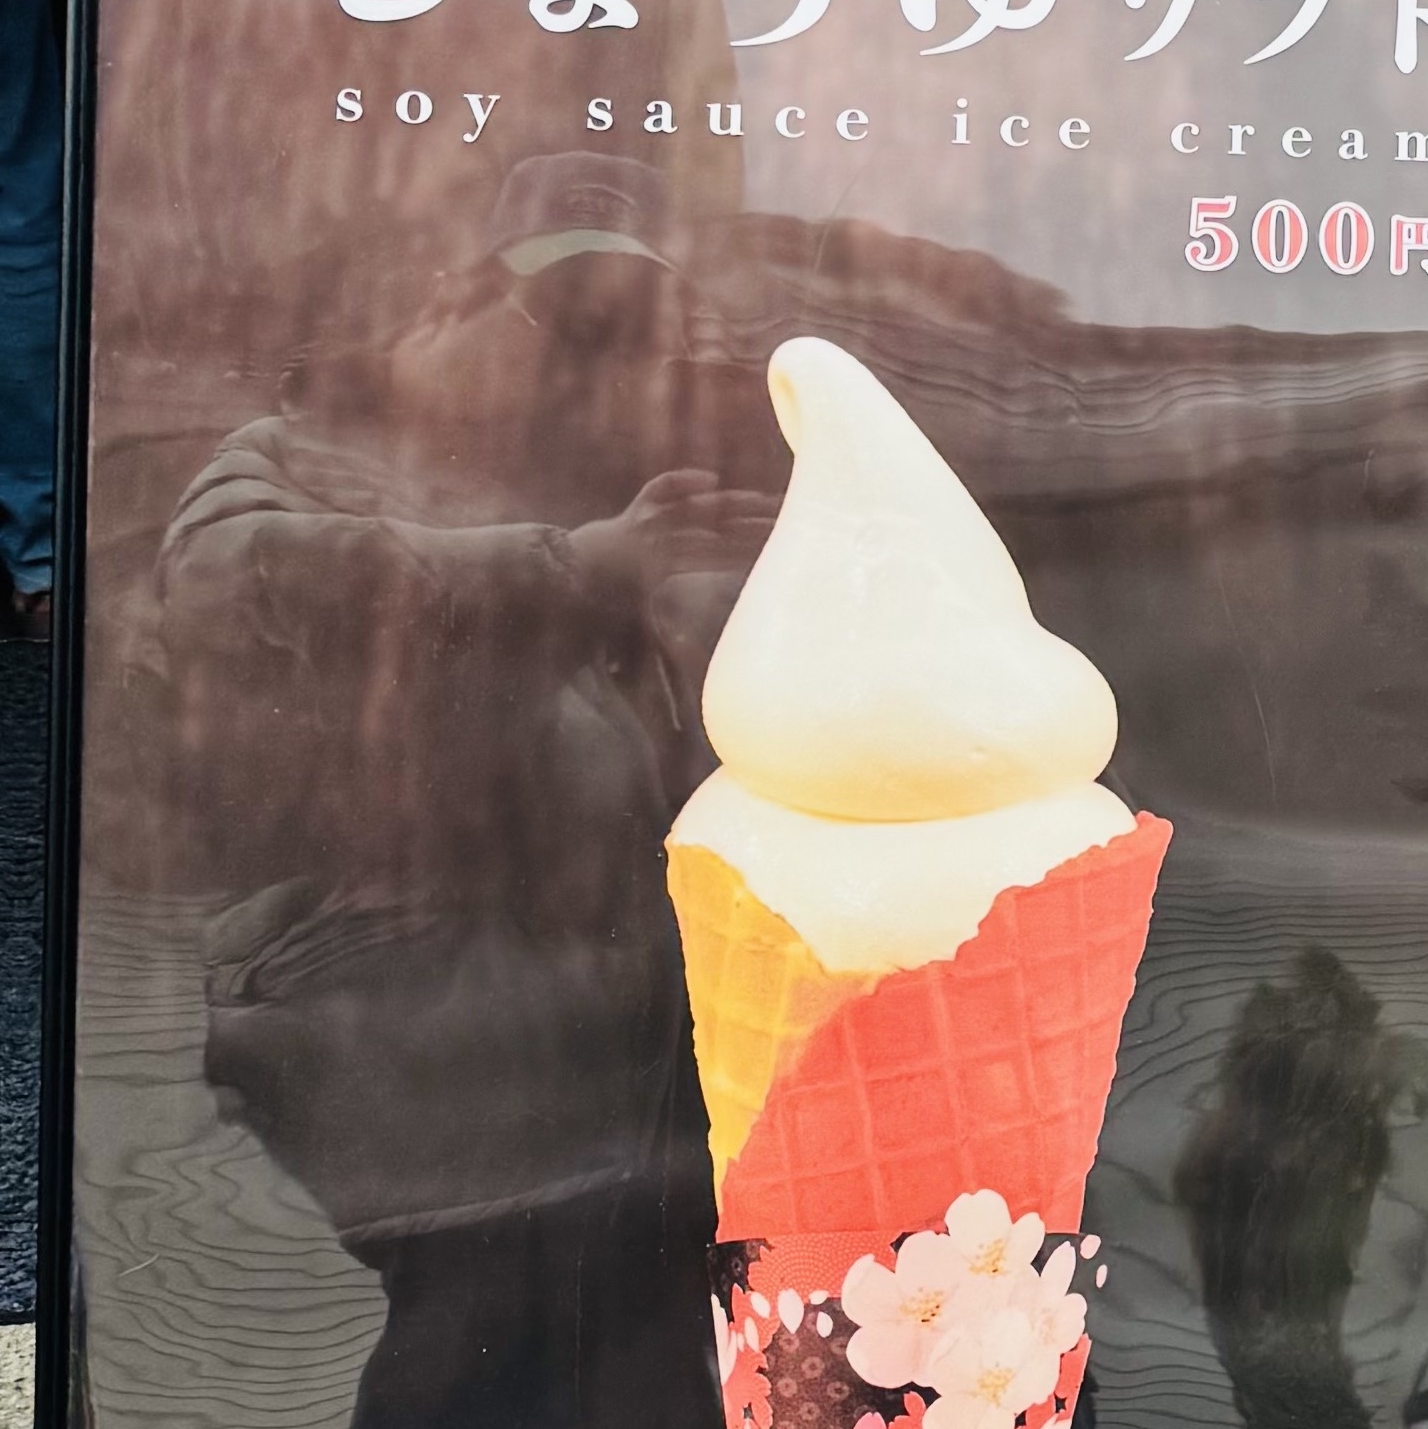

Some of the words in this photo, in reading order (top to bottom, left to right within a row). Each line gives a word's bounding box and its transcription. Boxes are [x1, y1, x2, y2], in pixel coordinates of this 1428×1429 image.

[335, 79, 502, 144] soy
[586, 92, 870, 142] sauce
[951, 97, 1093, 150] ice
